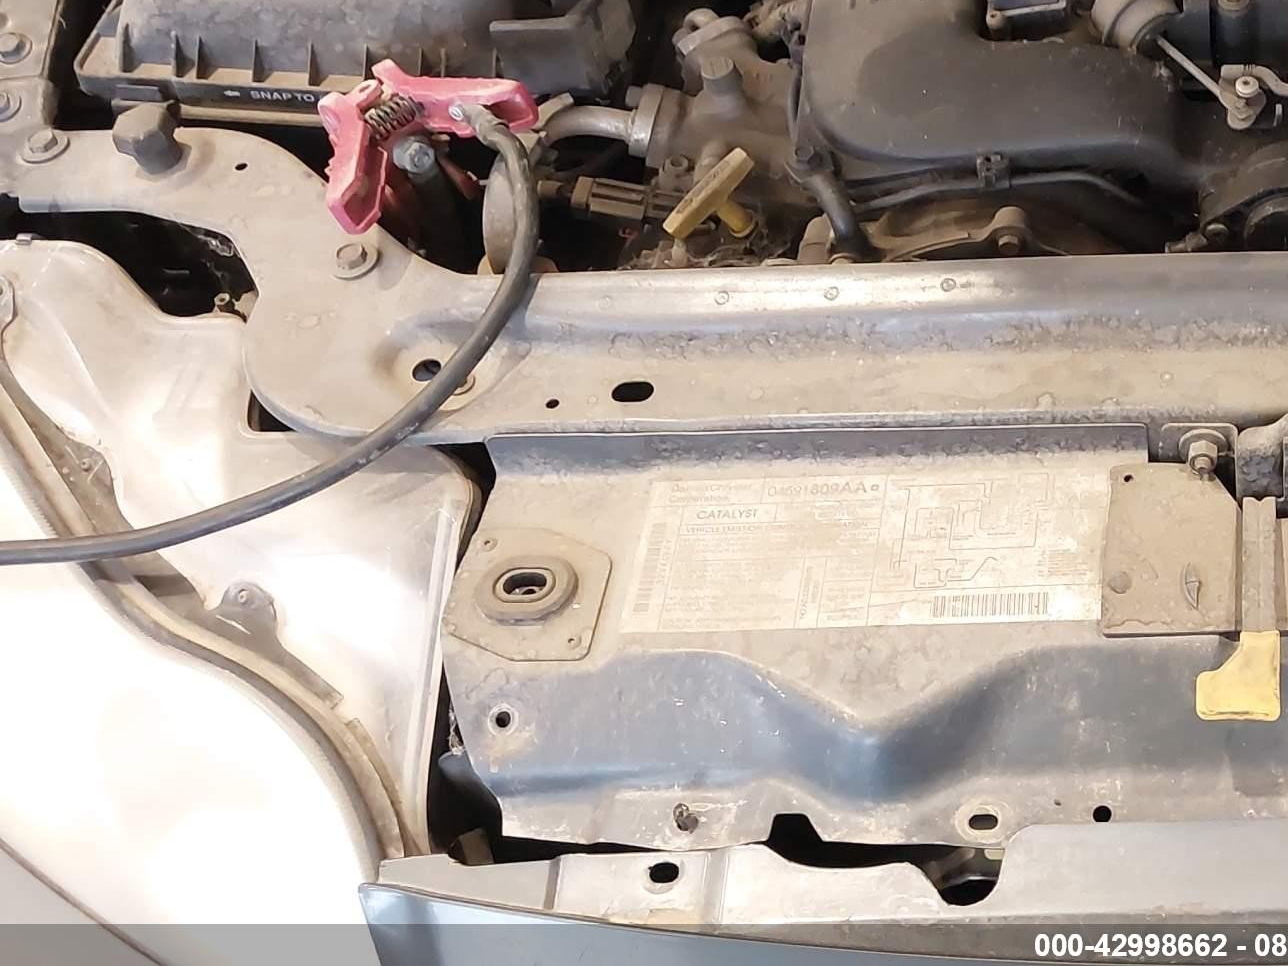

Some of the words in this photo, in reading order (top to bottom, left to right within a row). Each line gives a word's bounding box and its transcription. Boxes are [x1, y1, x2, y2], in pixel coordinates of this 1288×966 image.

[250, 90, 292, 101] SNAP
[294, 93, 316, 102] TO
[696, 508, 760, 520] CATALYST
